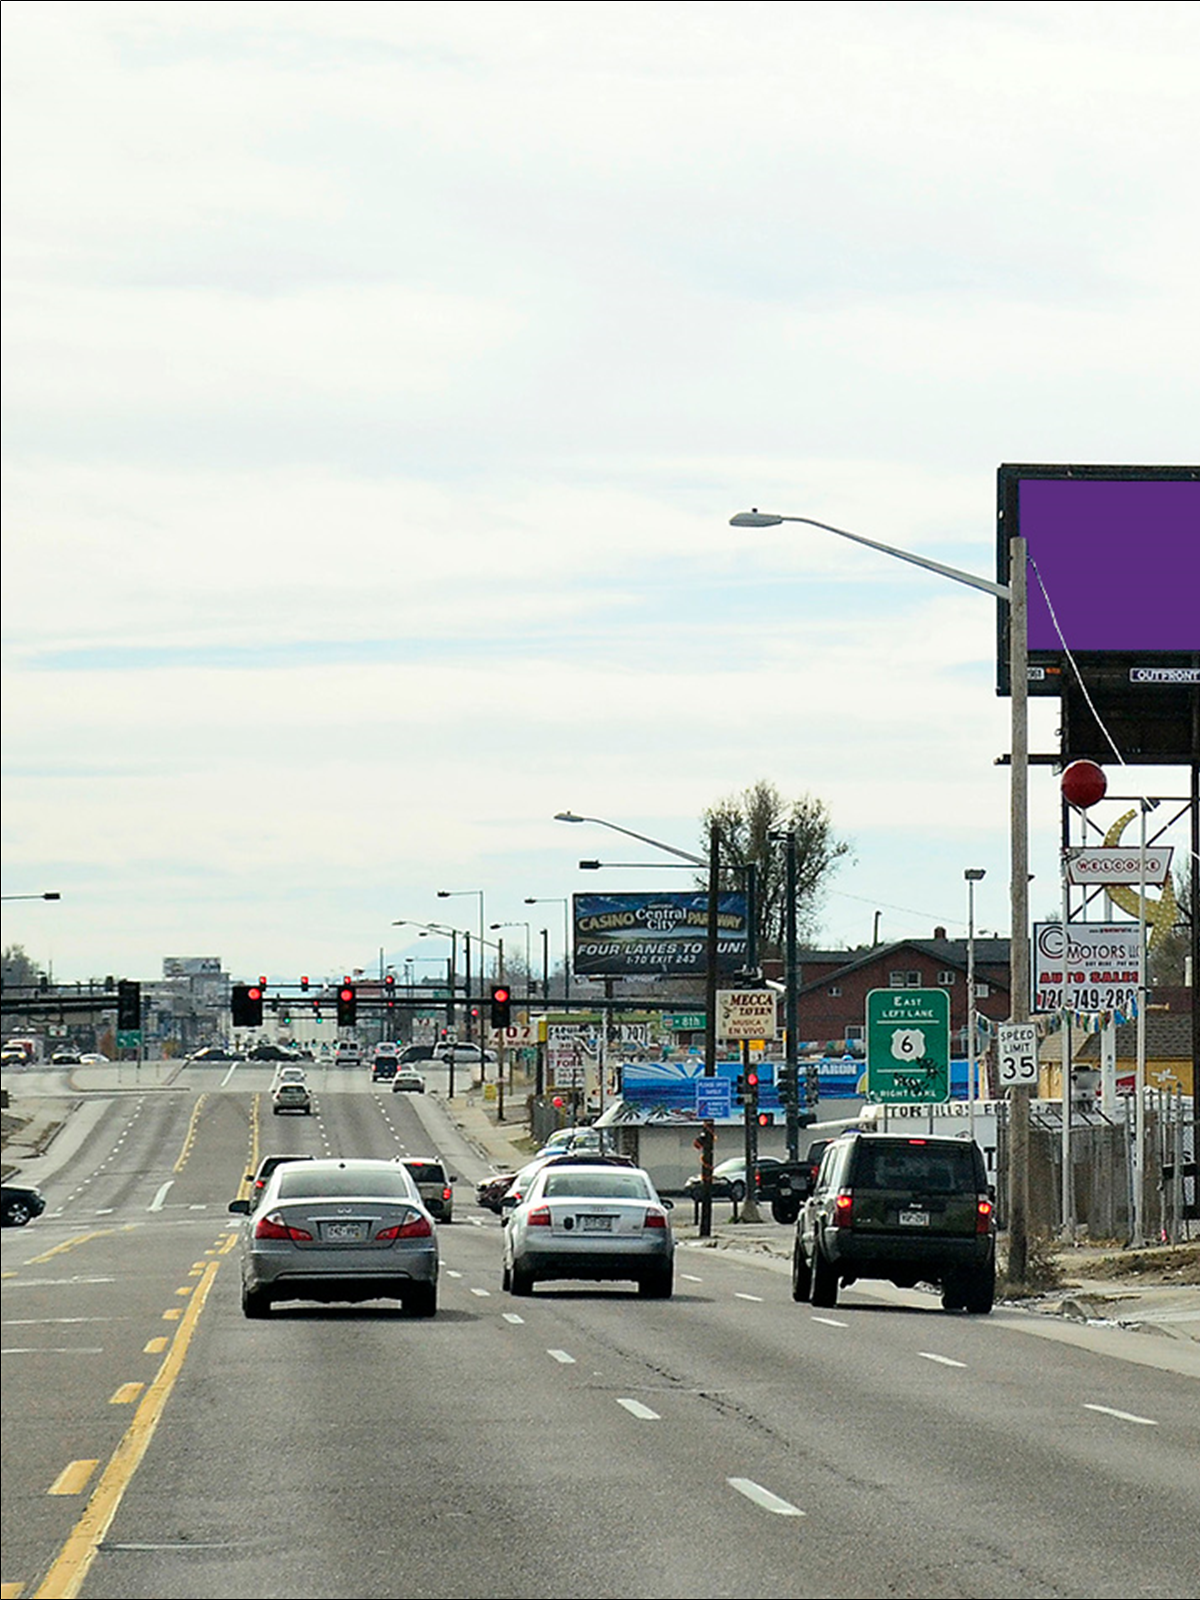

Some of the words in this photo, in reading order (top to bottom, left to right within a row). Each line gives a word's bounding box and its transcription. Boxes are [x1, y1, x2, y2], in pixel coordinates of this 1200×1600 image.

[1137, 671, 1200, 681] OUTFRONT
[1078, 860, 1158, 871] WELCOE
[578, 912, 635, 931] CASINO
[635, 907, 687, 920] Central
[687, 911, 743, 928] PARWAY
[647, 919, 677, 933] City
[577, 943, 621, 955] FOUR
[625, 943, 677, 955] LANES
[679, 942, 703, 954] TO
[714, 942, 746, 953] UN!
[1068, 945, 1126, 959] MOTORS
[650, 955, 673, 963] EXIT
[1039, 971, 1085, 983] AUTO
[1089, 971, 1139, 983] SALES
[730, 994, 773, 1006] MECCA
[893, 996, 922, 1006] EAST
[882, 1009, 907, 1018] LEFT
[908, 1009, 934, 1018] LANE
[681, 1015, 700, 1026] 8th
[728, 1027, 742, 1035] EN
[743, 1027, 766, 1035] VIVO
[1001, 1029, 1034, 1042] SPEED
[901, 1035, 914, 1053] 6
[1003, 1043, 1031, 1053] LIMIT
[1003, 1056, 1035, 1079] 35
[880, 1090, 907, 1098] RIGHT
